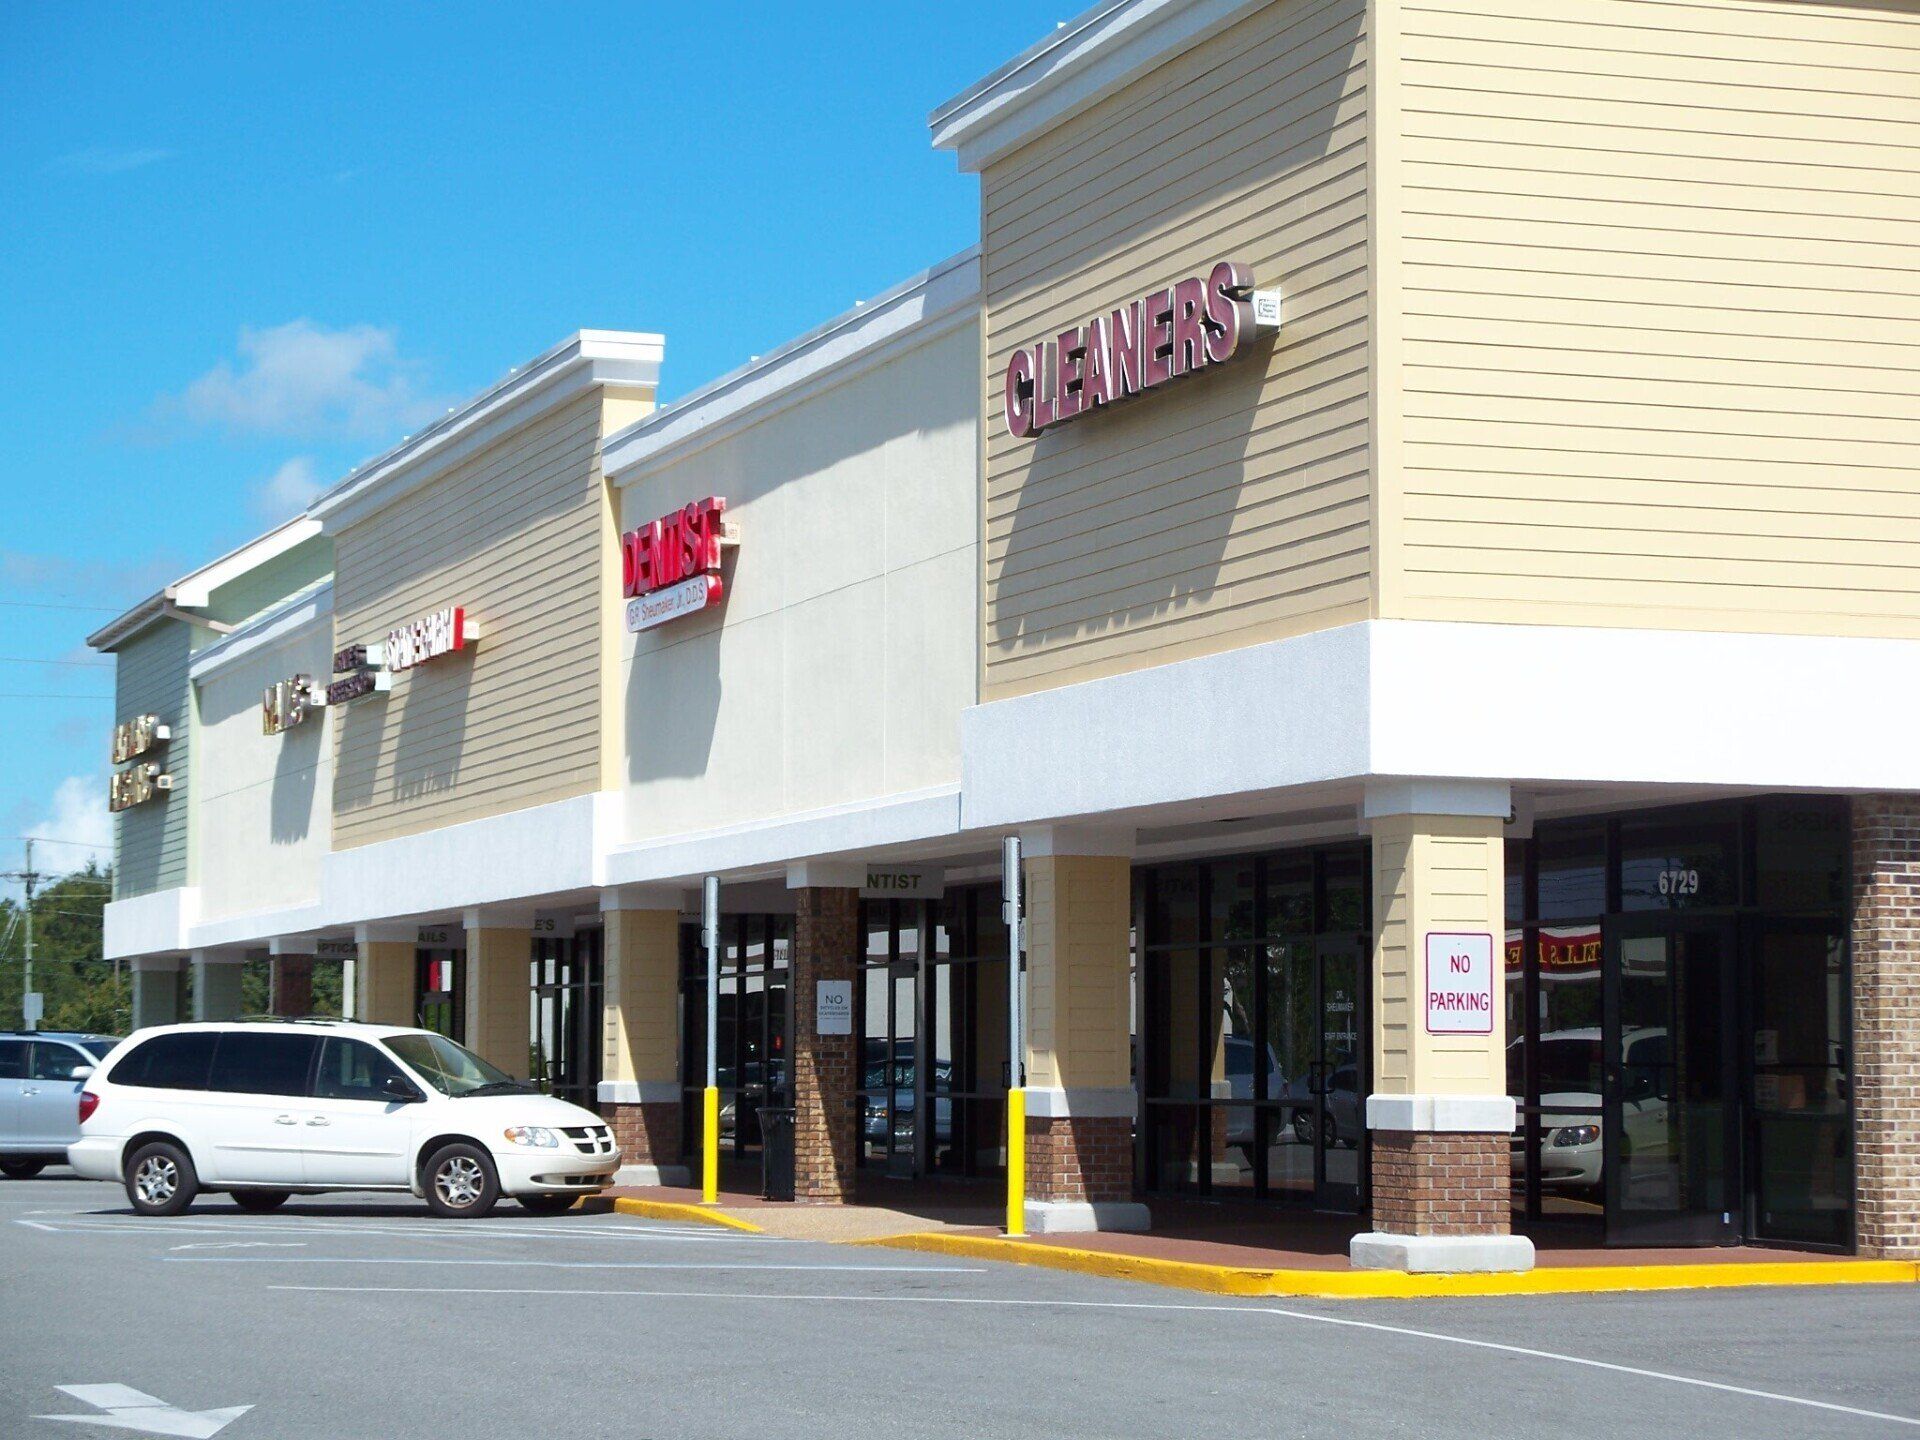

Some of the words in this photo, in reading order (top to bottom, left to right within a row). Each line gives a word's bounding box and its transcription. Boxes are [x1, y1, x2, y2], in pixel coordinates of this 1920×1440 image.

[1003, 262, 1255, 438] CLEANERS
[623, 497, 724, 598] DENTIST
[867, 873, 922, 889] NTIST
[1659, 869, 1699, 895] 6729
[418, 930, 448, 944] AILS
[1450, 955, 1471, 973] NO
[825, 994, 843, 1005] NO
[1430, 992, 1489, 1011] PARKING
